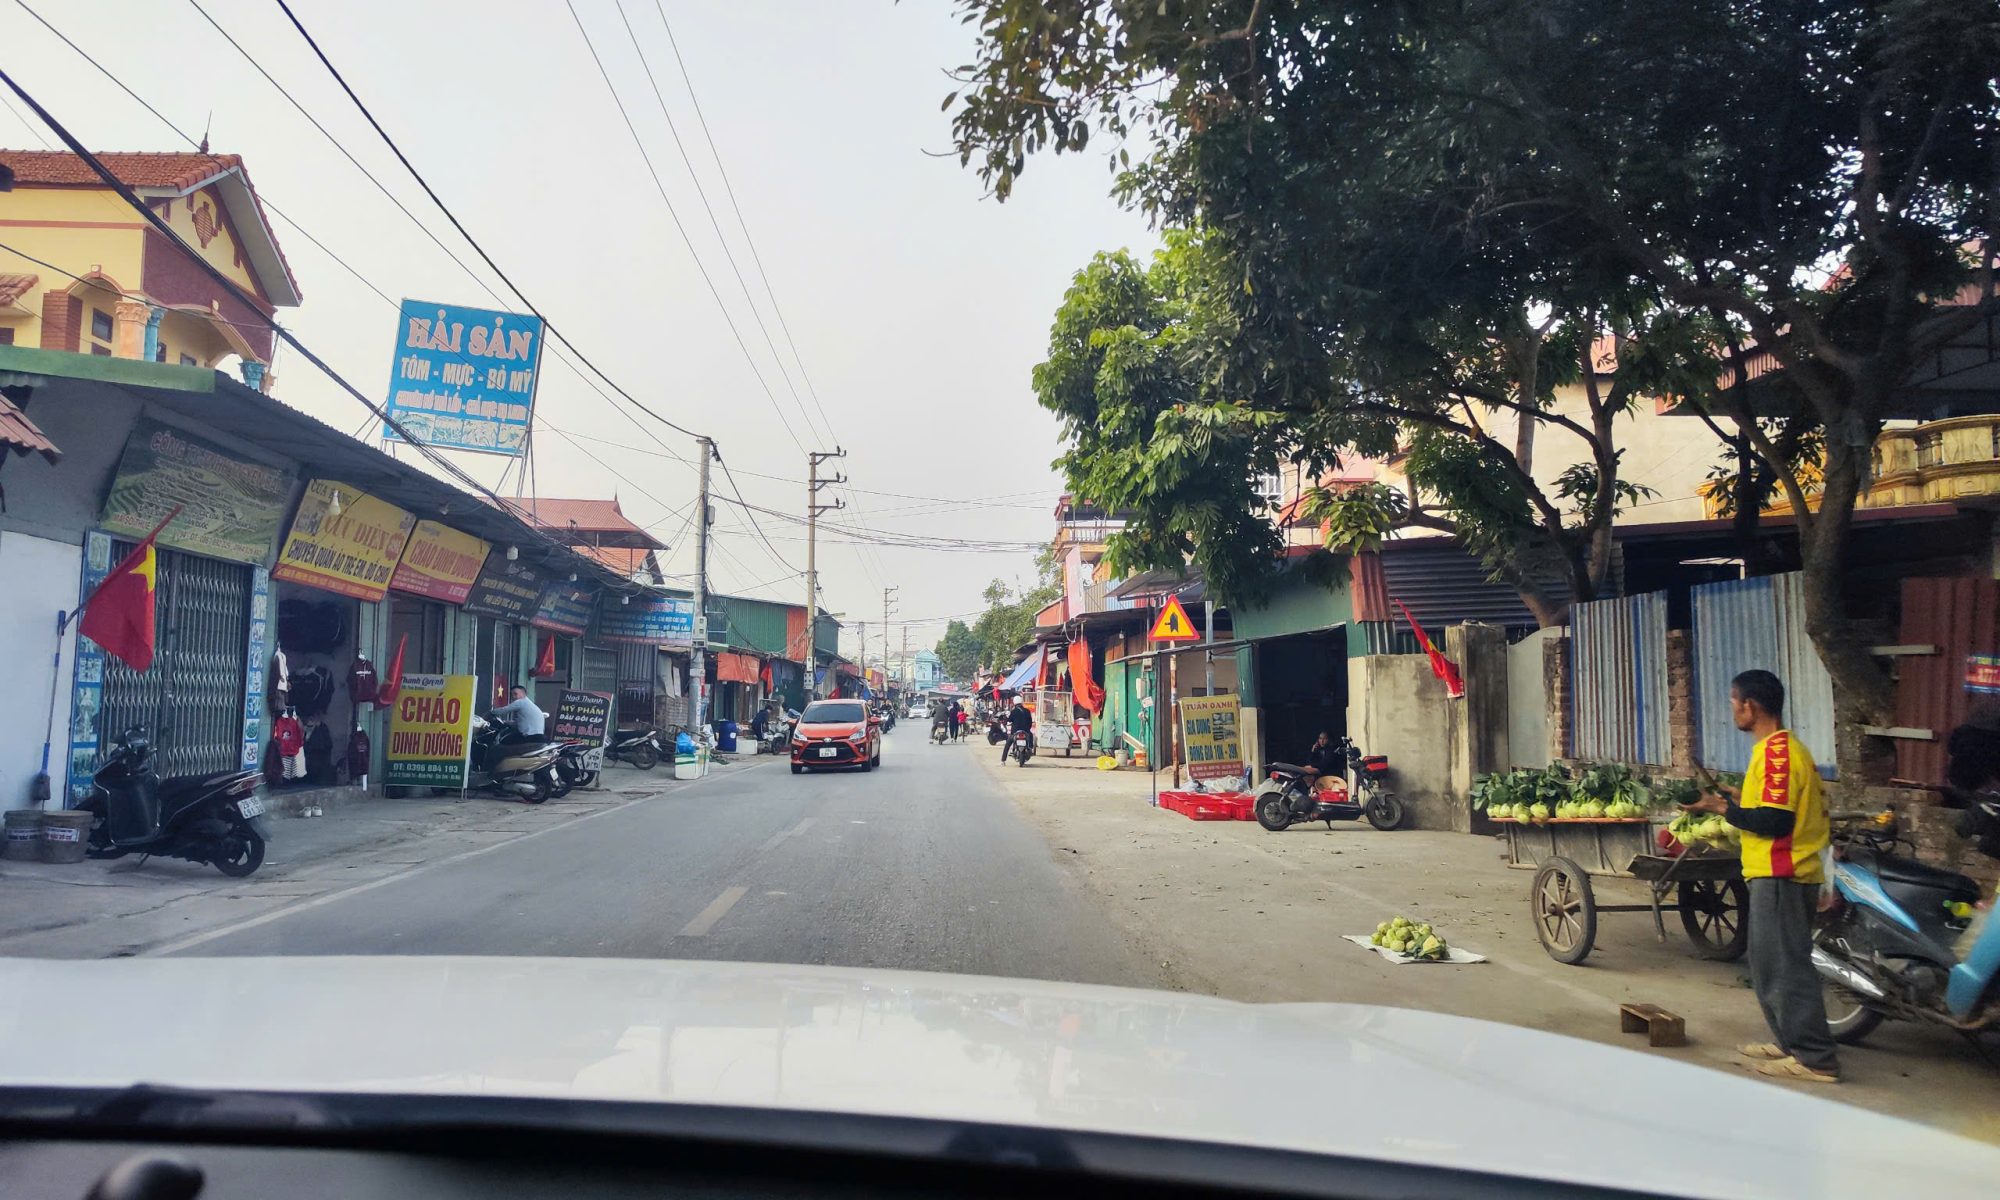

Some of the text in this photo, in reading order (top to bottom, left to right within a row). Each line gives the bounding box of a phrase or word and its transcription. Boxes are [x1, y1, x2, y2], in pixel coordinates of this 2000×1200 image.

[406, 309, 532, 362] HẢI SẢN
[401, 354, 431, 381] TÔM
[442, 363, 475, 389] MỰC
[509, 368, 532, 393] MỸ
[151, 430, 186, 460] CÔNG
[287, 538, 318, 564] CHUYÊN
[314, 545, 337, 568] QUẦN
[409, 539, 438, 568] CHÁO
[401, 692, 460, 724] CHÁO
[561, 705, 604, 715] MỸ PHẨM
[1185, 700, 1208, 710] TUẤN
[392, 728, 463, 756] DINH DƯỠNG
